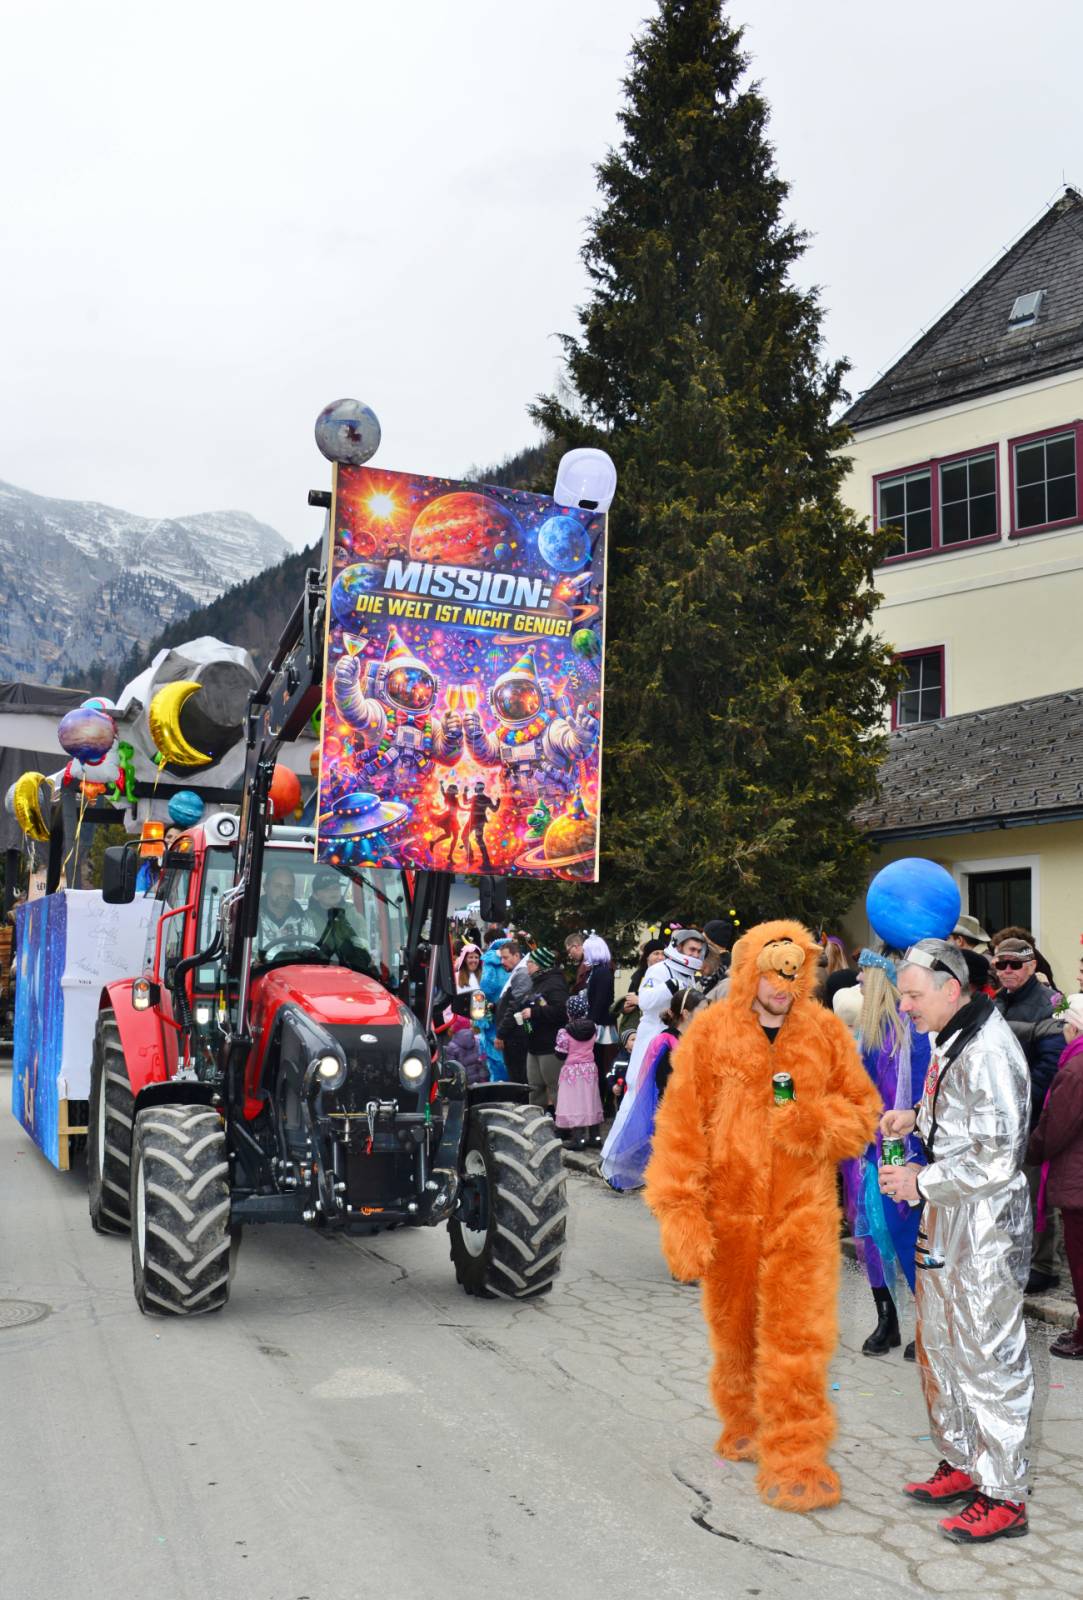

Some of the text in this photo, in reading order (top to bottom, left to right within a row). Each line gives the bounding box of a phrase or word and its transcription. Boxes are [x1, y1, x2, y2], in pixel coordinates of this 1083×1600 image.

[383, 559, 552, 608] MISSION:
[355, 594, 573, 637] DIE WELT IST NICHT GENUG!
